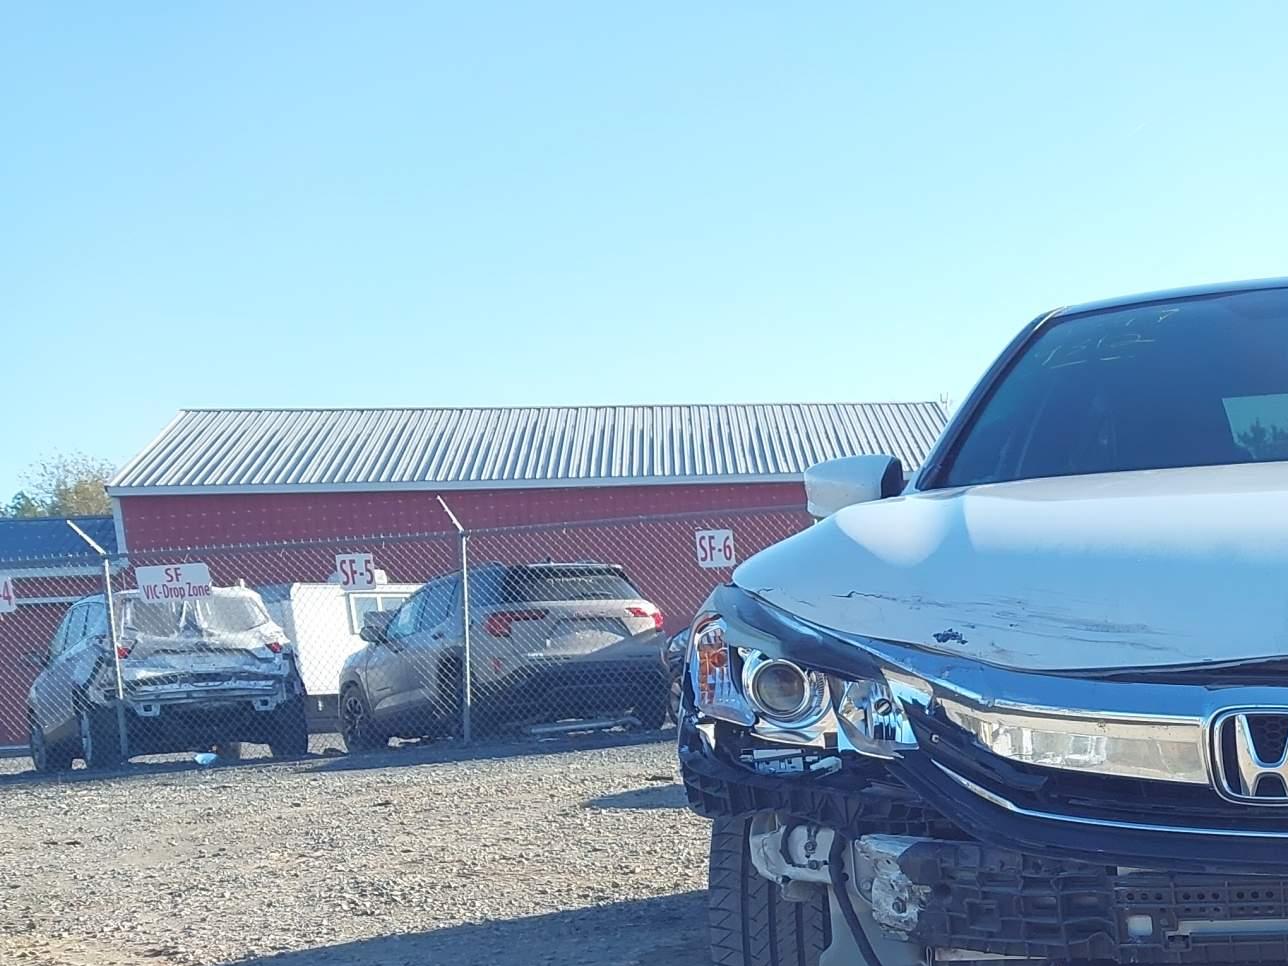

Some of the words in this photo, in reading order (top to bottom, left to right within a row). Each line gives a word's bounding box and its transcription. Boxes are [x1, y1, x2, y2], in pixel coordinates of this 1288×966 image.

[699, 535, 732, 562] SF-6
[164, 567, 182, 582] SF
[340, 559, 374, 585] SF-5
[143, 584, 186, 600] VIC-Drop
[186, 582, 210, 597] Zone
